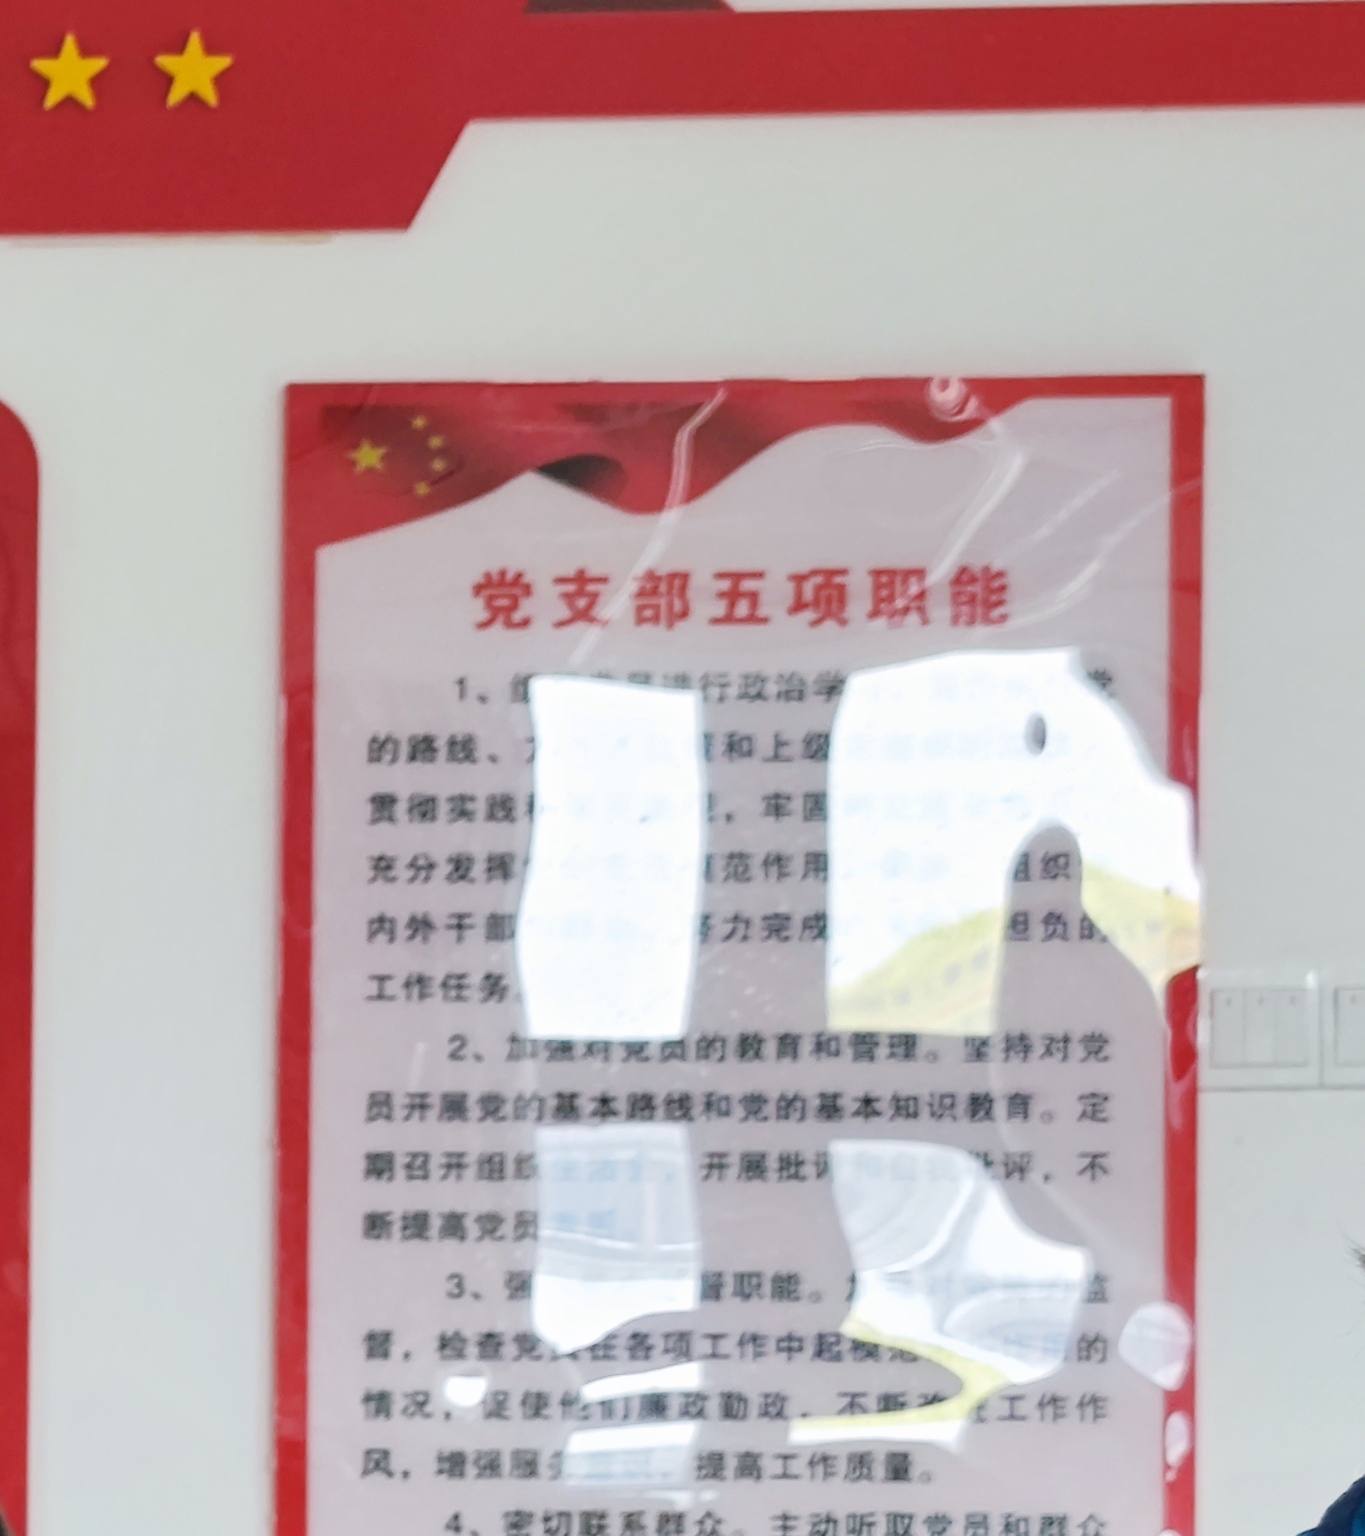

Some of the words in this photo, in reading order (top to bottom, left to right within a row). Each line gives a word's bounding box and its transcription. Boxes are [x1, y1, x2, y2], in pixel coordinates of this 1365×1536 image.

[473, 567, 1012, 631] 党支部五项职能
